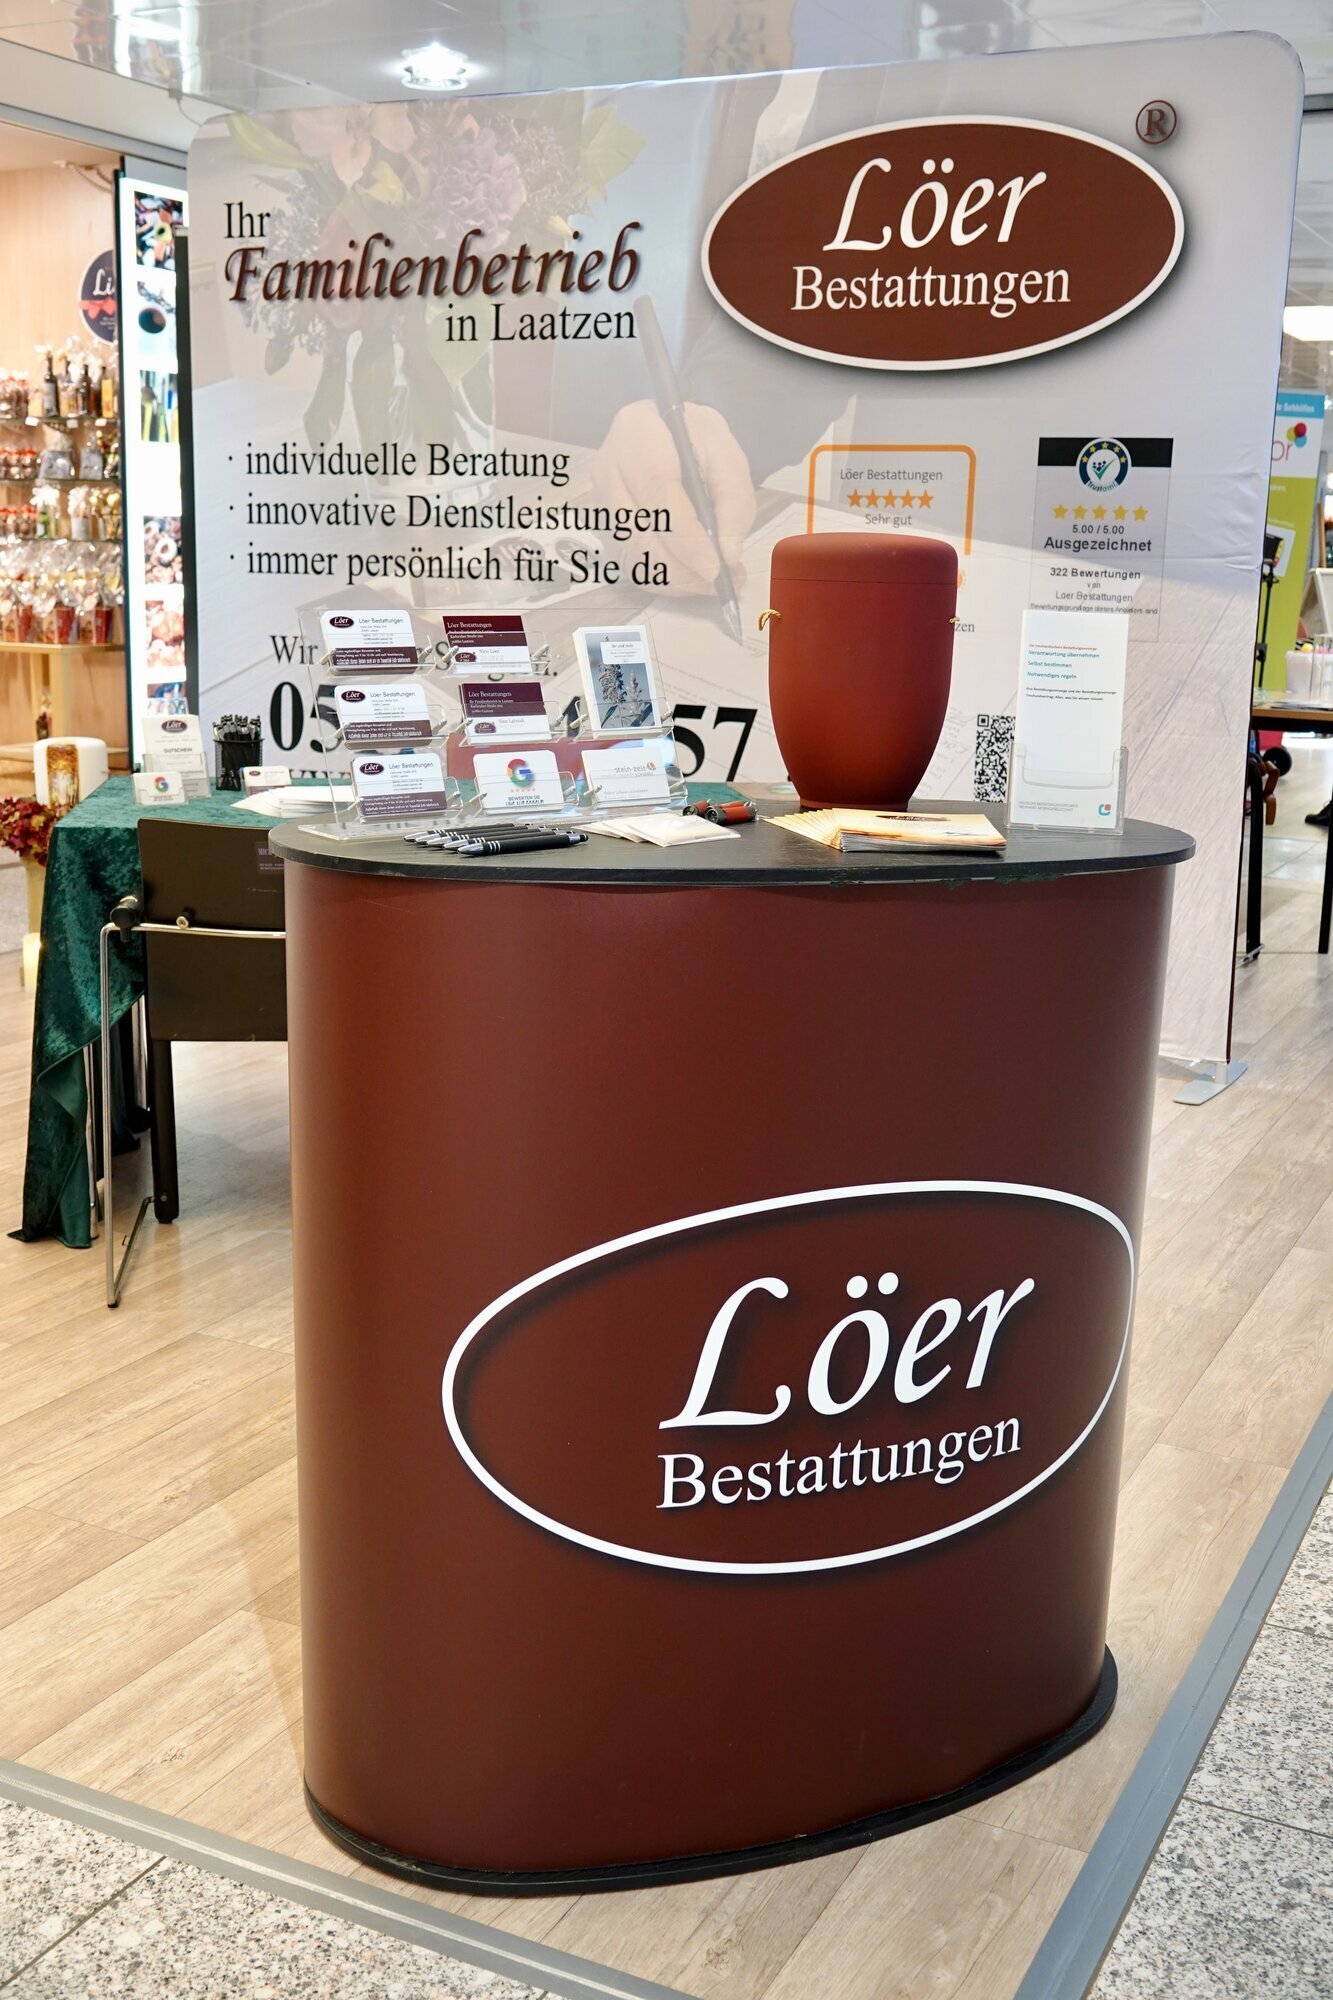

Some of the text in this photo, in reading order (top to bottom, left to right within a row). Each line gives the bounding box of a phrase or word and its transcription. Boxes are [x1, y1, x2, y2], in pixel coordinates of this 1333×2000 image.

[224, 203, 271, 240] Ihr
[822, 158, 1047, 251] Löer
[224, 222, 641, 303] Familienbetrieb
[791, 264, 1071, 318] Bestattungen
[445, 302, 637, 341] in Laatzen
[245, 442, 571, 486] individuelle Beratung
[839, 468, 943, 484] Löer Bestattungen
[246, 494, 672, 539] innovative Dienstleistungen
[864, 513, 913, 529] Sehr gut
[1072, 524, 1094, 534] 5.00
[1102, 525, 1125, 535] 5.00
[1044, 536, 1152, 552] Ausgezeichnet
[247, 543, 670, 586] immer persönlich für Sie da
[1050, 567, 1141, 580] 322 Bewertungen
[1076, 591, 1133, 604] Bestattungen
[270, 635, 317, 665] Wir
[1029, 650, 1067, 658] Verantwortung
[658, 1272, 1035, 1431] Löer
[656, 1417, 1022, 1509] Bestattungen
